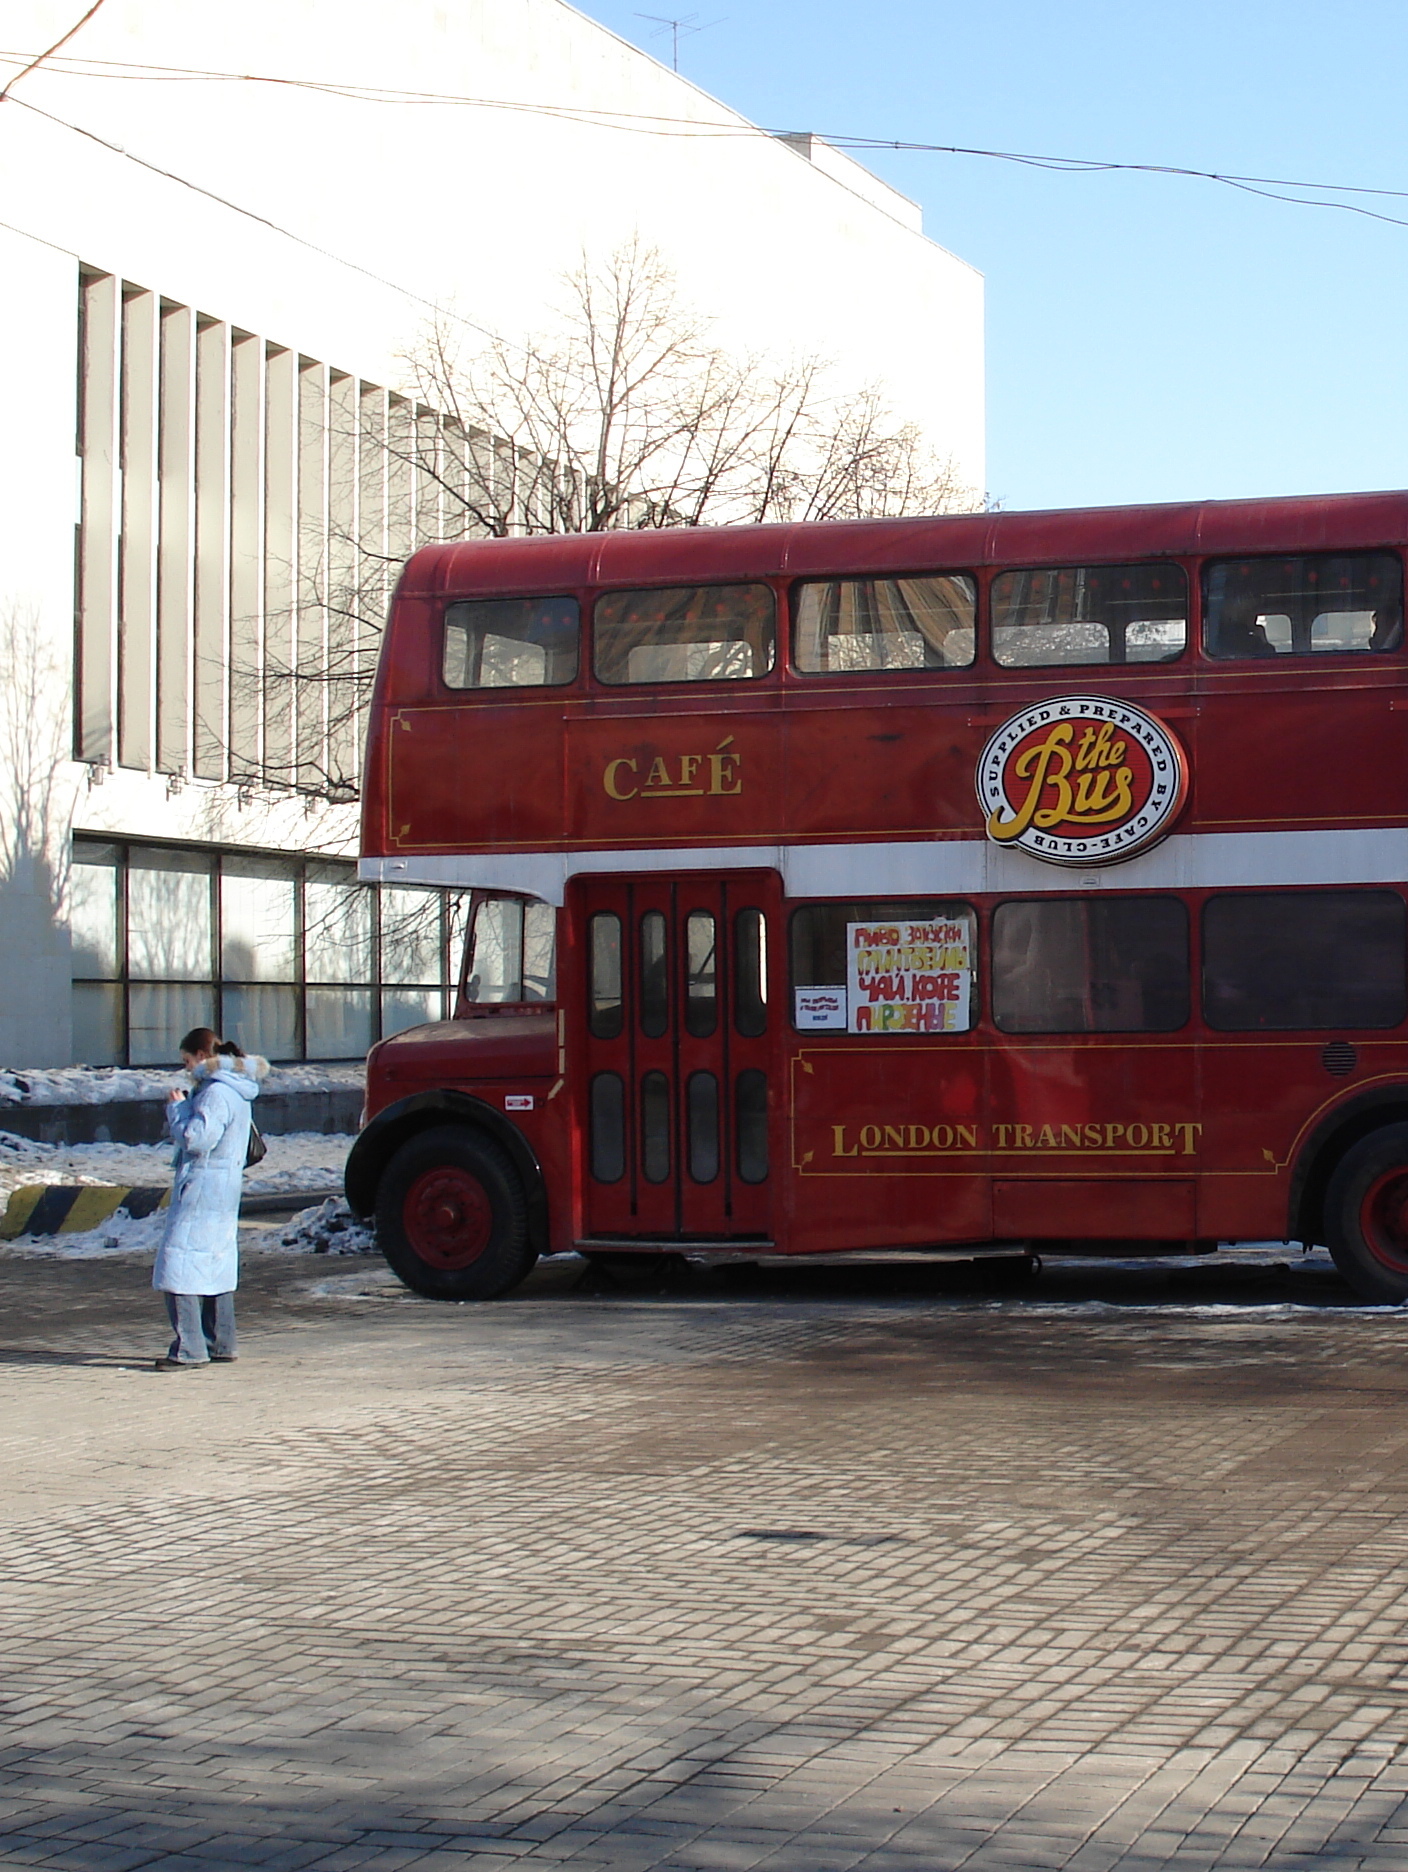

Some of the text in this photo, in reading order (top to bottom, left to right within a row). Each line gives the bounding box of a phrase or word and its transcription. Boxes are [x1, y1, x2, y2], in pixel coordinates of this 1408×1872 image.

[603, 735, 742, 801] CAFÉ
[1075, 721, 1127, 771] the
[988, 723, 1133, 839] Bus
[989, 704, 1168, 853] SUPPLIED & PREPARED BY CAFE-CLUB
[854, 926, 900, 948] ПИВО
[831, 1122, 1203, 1157] LONDON TRANSPORT
